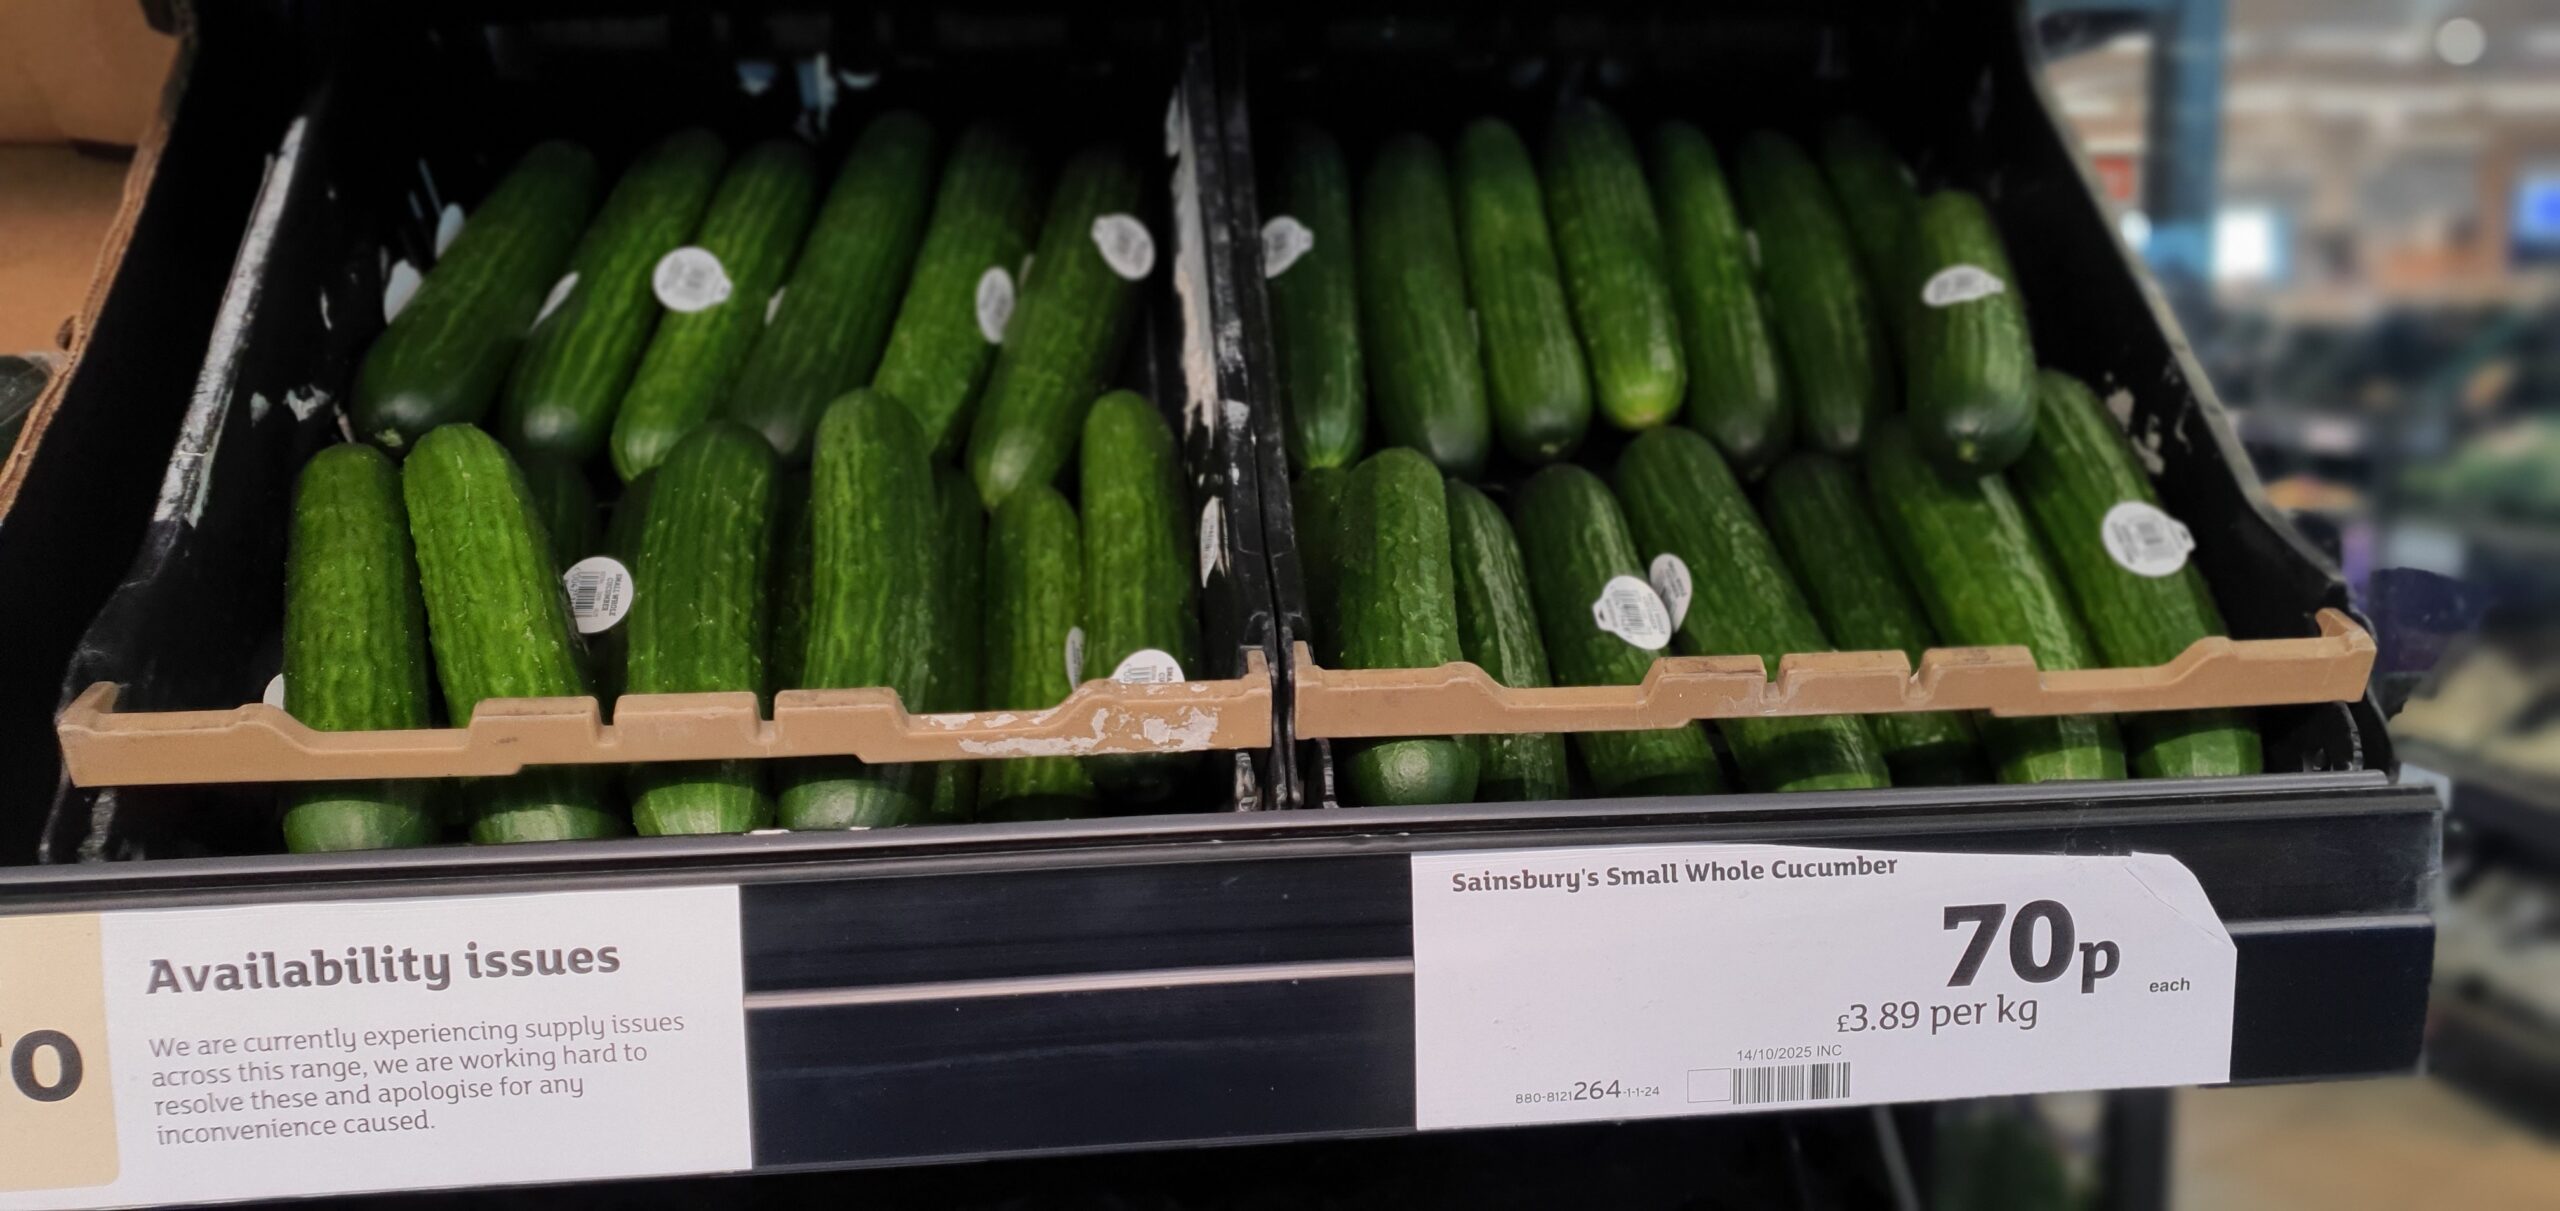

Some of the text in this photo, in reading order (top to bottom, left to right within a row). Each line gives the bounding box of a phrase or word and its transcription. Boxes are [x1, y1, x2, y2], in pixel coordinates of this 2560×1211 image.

[1452, 855, 1898, 894] Sainsbury's Small Whole Cucumber
[145, 940, 621, 995] Availability issues
[1943, 899, 2121, 995] 70p
[2149, 977, 2191, 993] each
[1836, 993, 2038, 1036] £3.89 per kg
[149, 1014, 685, 1058] We are currently experiencing supply issues
[1736, 1044, 1843, 1063] 14/10/2025 INC
[152, 1043, 648, 1087] across this range, we are working hard to
[154, 1075, 584, 1116] resolve these and apologise for any
[156, 1109, 436, 1146] inconvenience caused.
